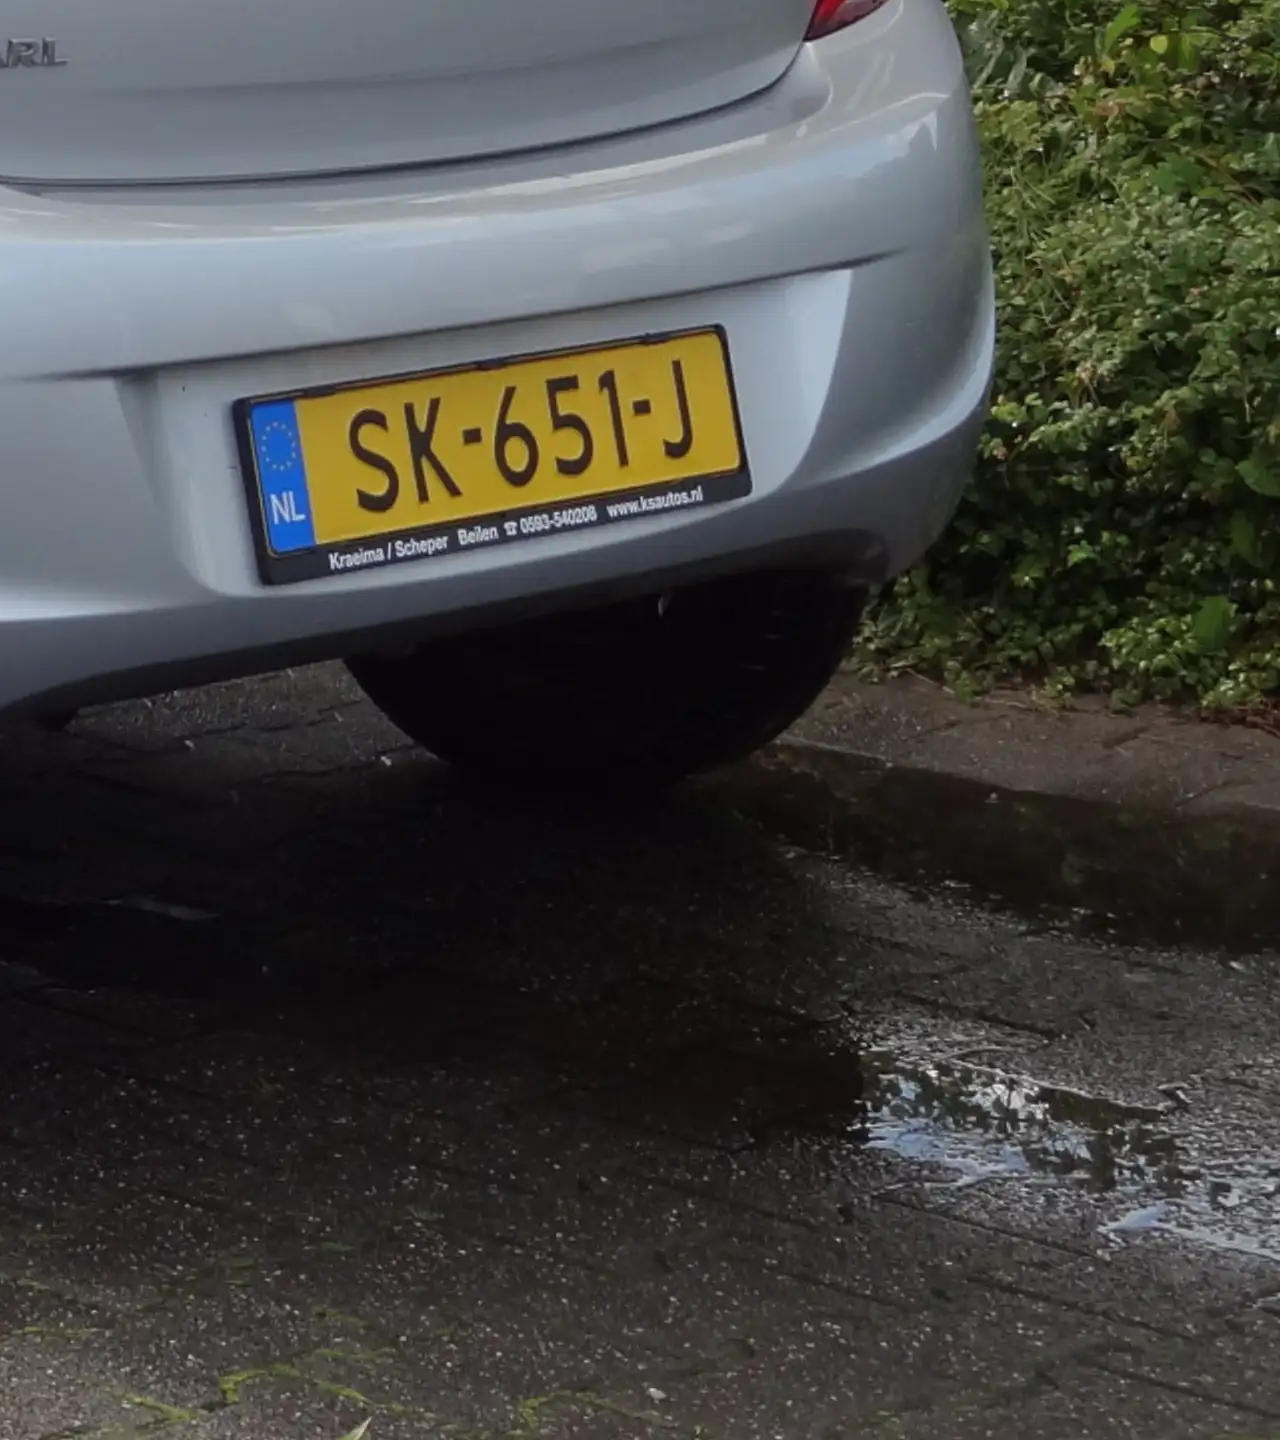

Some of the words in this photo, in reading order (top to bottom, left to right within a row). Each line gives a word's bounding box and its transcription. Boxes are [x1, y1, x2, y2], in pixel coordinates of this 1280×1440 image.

[348, 359, 694, 513] SK-651-J
[269, 492, 306, 527] NL
[457, 525, 500, 546] Beilen
[606, 484, 704, 518] www.ksautos.nl
